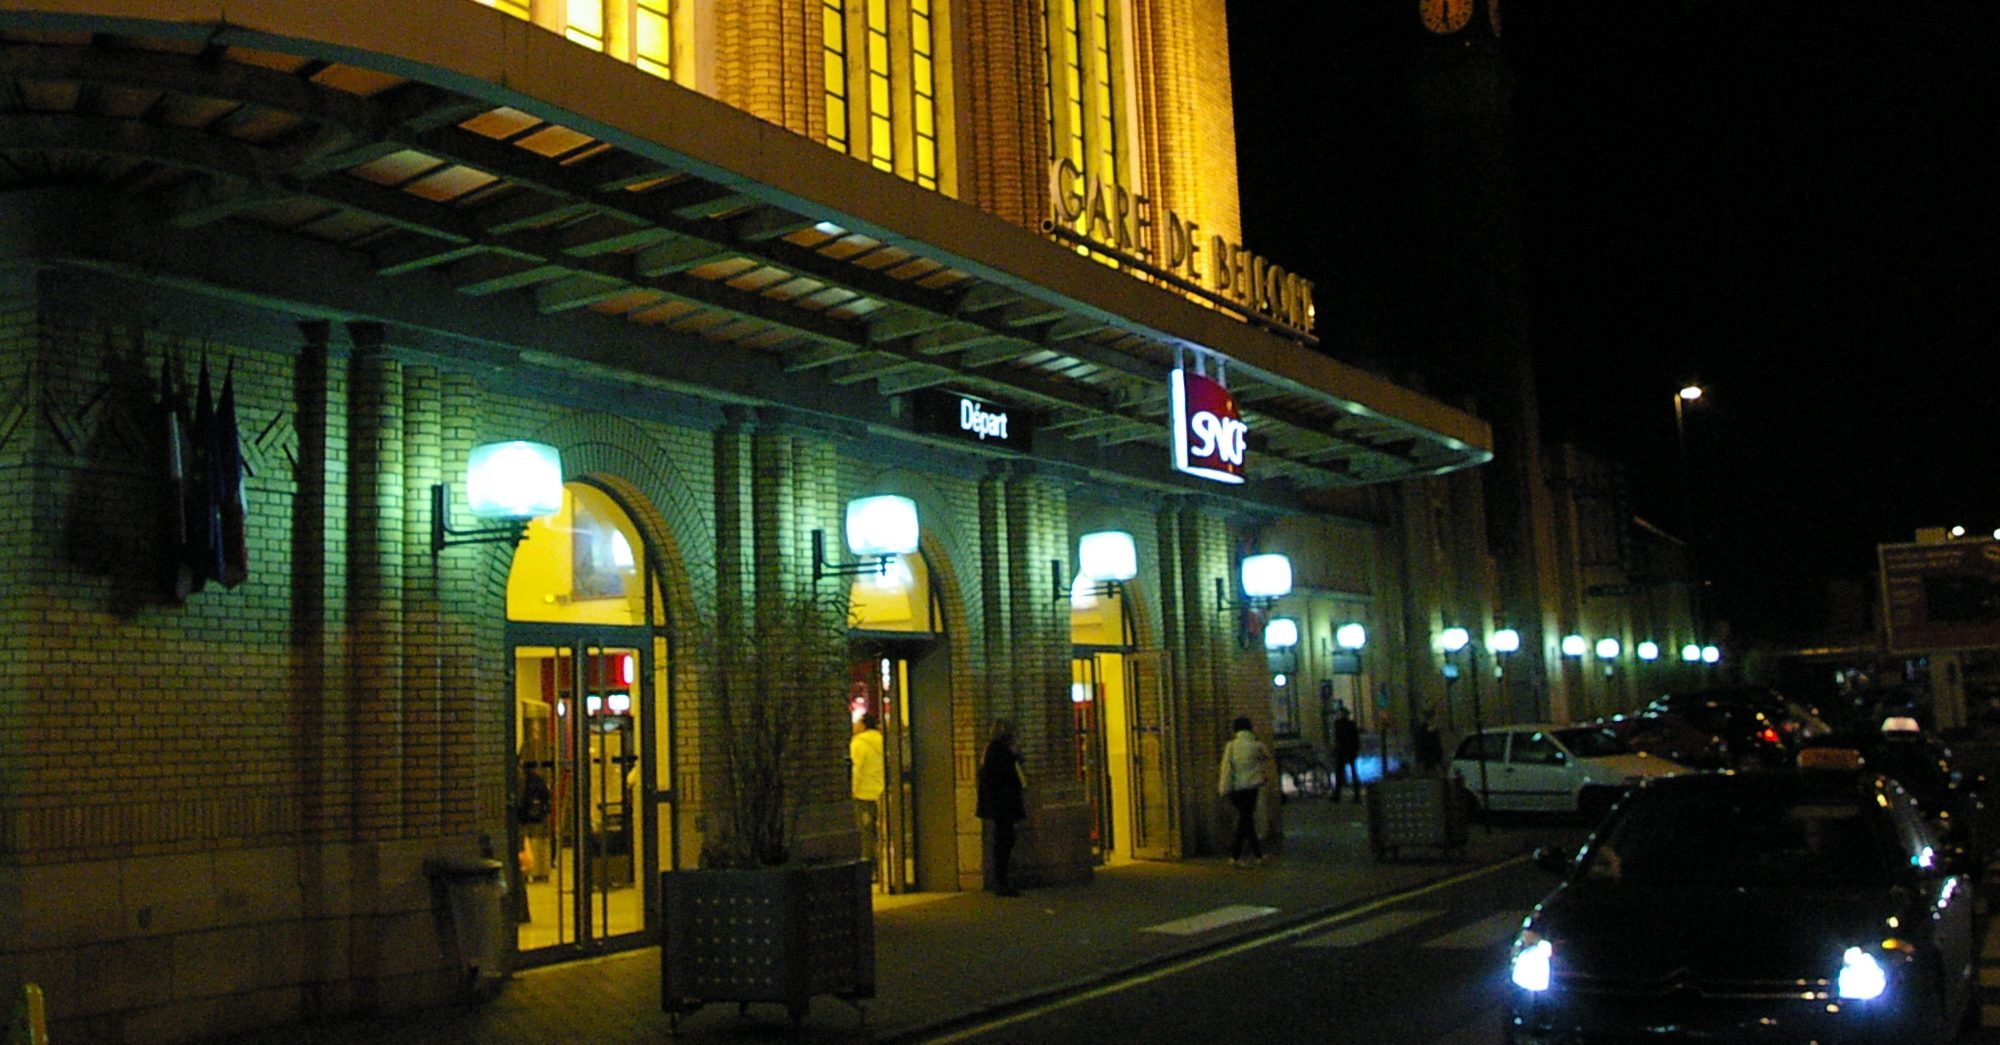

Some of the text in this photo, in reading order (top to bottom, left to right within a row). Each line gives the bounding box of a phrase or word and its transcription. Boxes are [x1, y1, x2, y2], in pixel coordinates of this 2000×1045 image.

[1051, 157, 1151, 257] GARE
[1163, 208, 1201, 278] DE
[960, 397, 1009, 440] Départ
[1190, 409, 1249, 466] SNCF
